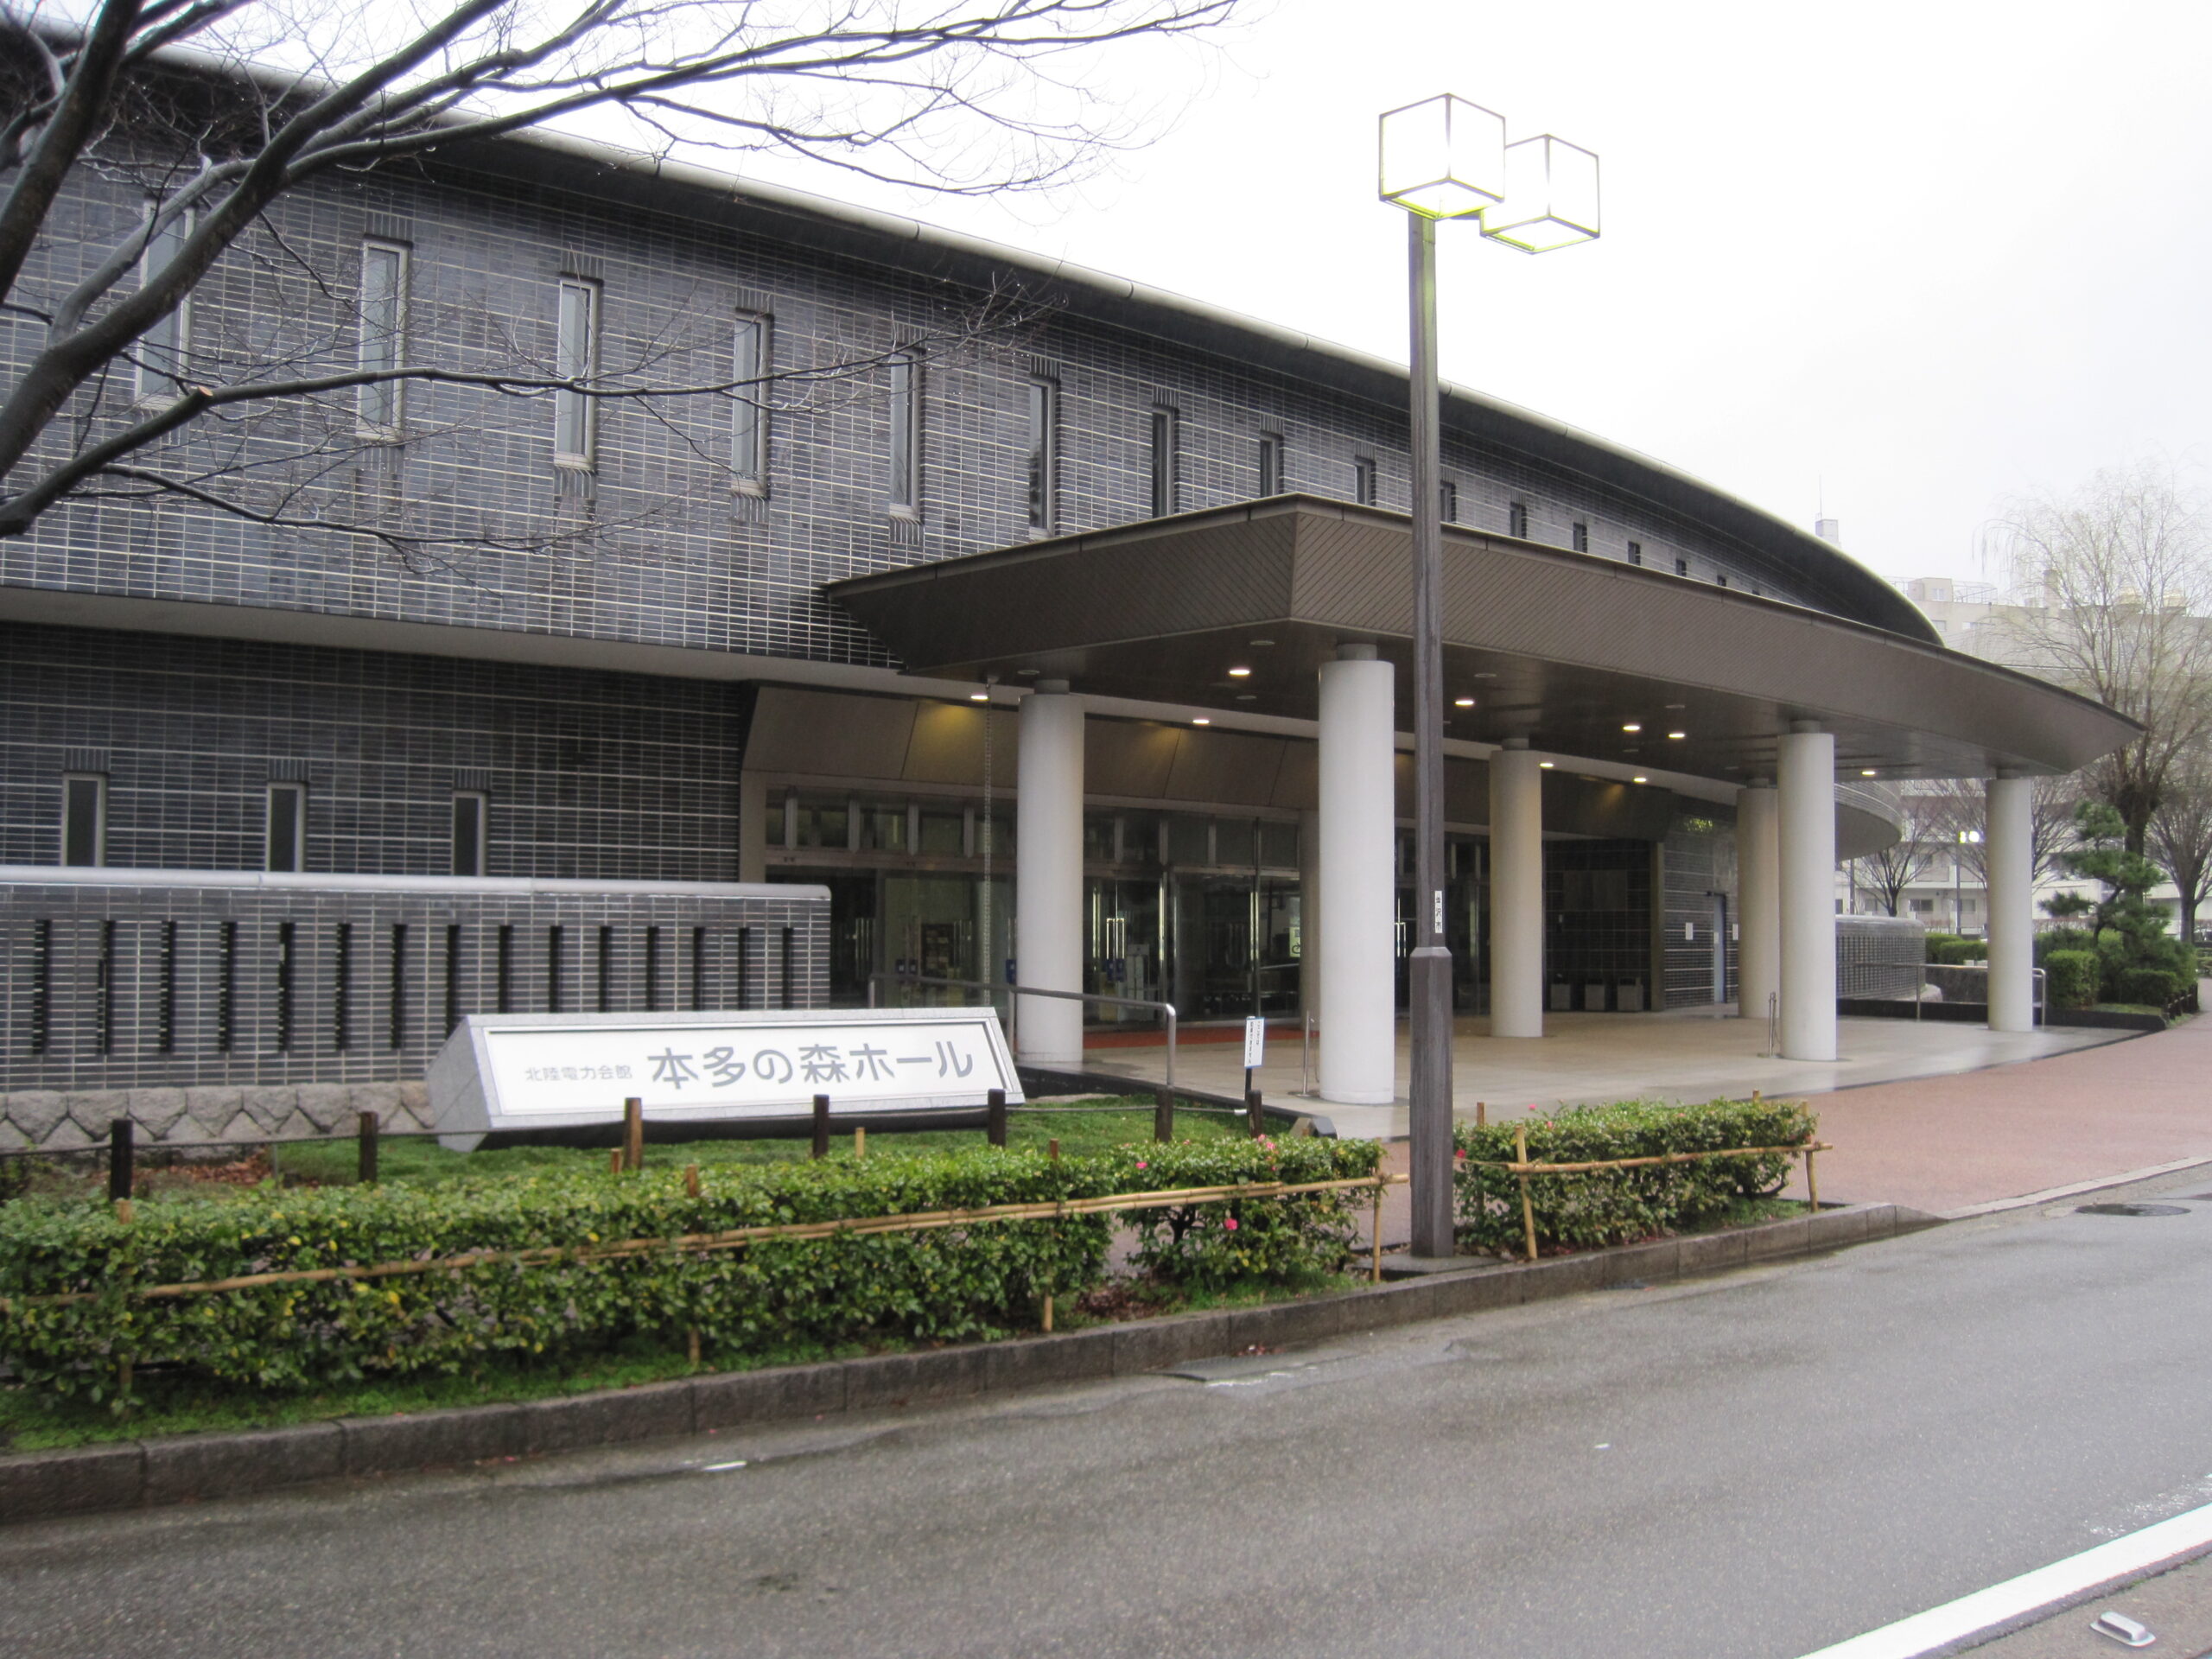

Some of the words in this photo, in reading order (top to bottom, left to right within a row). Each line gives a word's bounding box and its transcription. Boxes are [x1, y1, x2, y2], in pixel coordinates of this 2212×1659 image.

[525, 1065, 632, 1081] 北陸電力会館
[647, 1040, 974, 1090] 本多の森ホール
